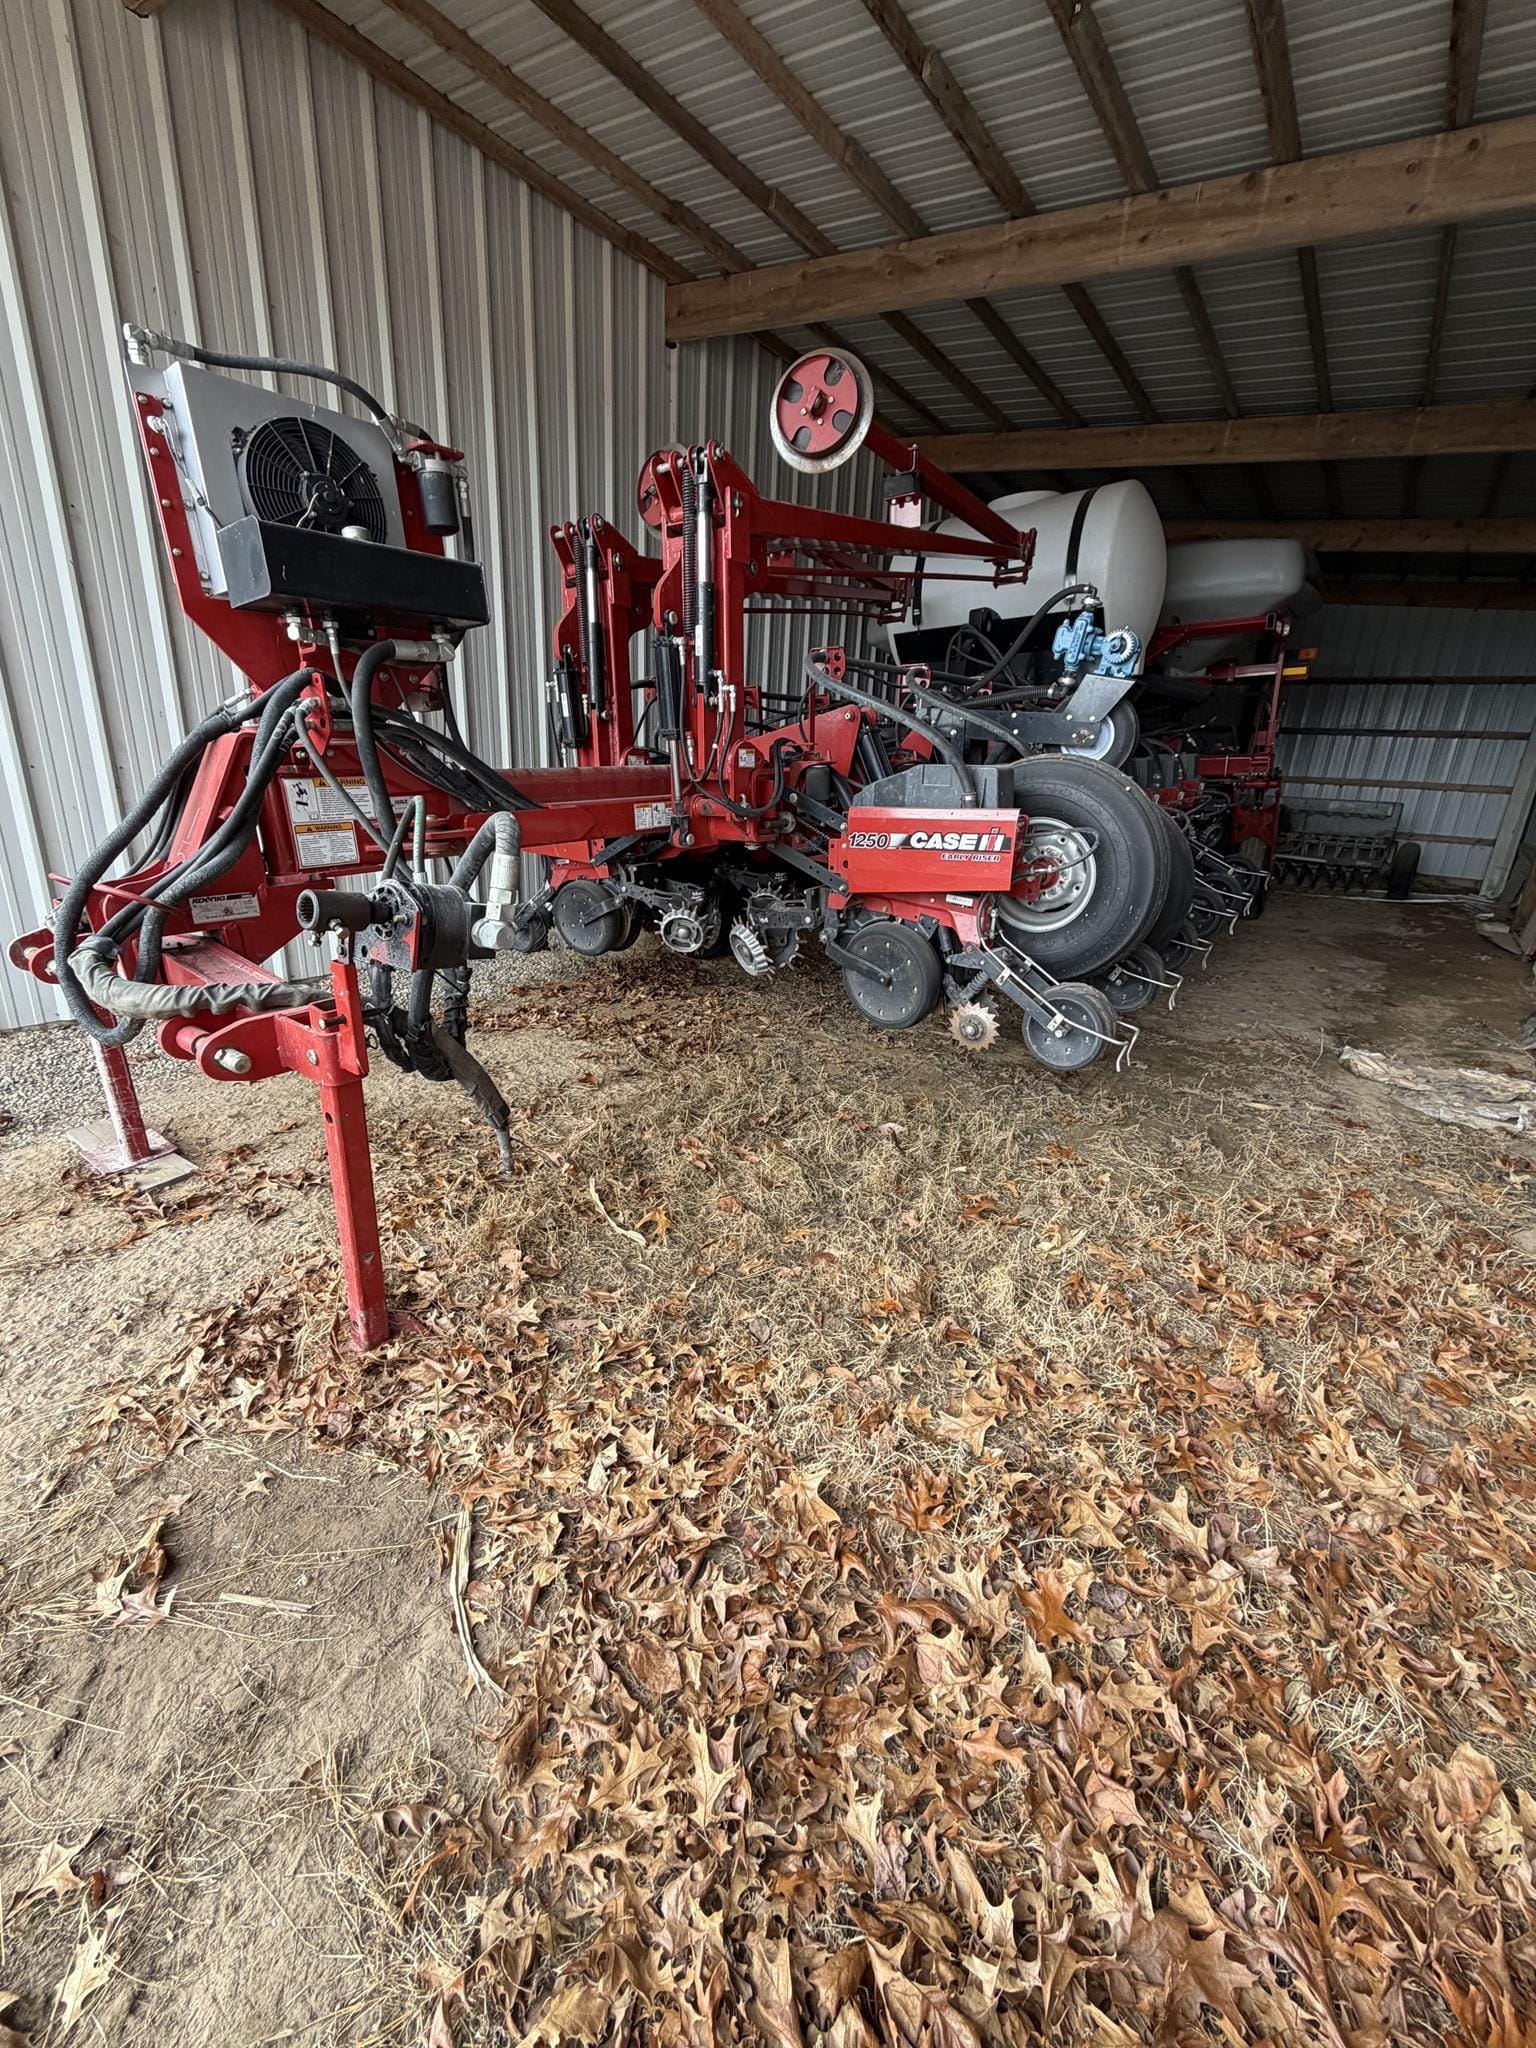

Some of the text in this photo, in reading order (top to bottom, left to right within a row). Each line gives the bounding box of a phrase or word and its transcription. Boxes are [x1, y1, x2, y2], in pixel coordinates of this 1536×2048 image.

[315, 824, 342, 832] WARNING
[848, 832, 889, 849] 1250
[910, 831, 979, 850] CASE
[941, 853, 1001, 863] EARLY RISER
